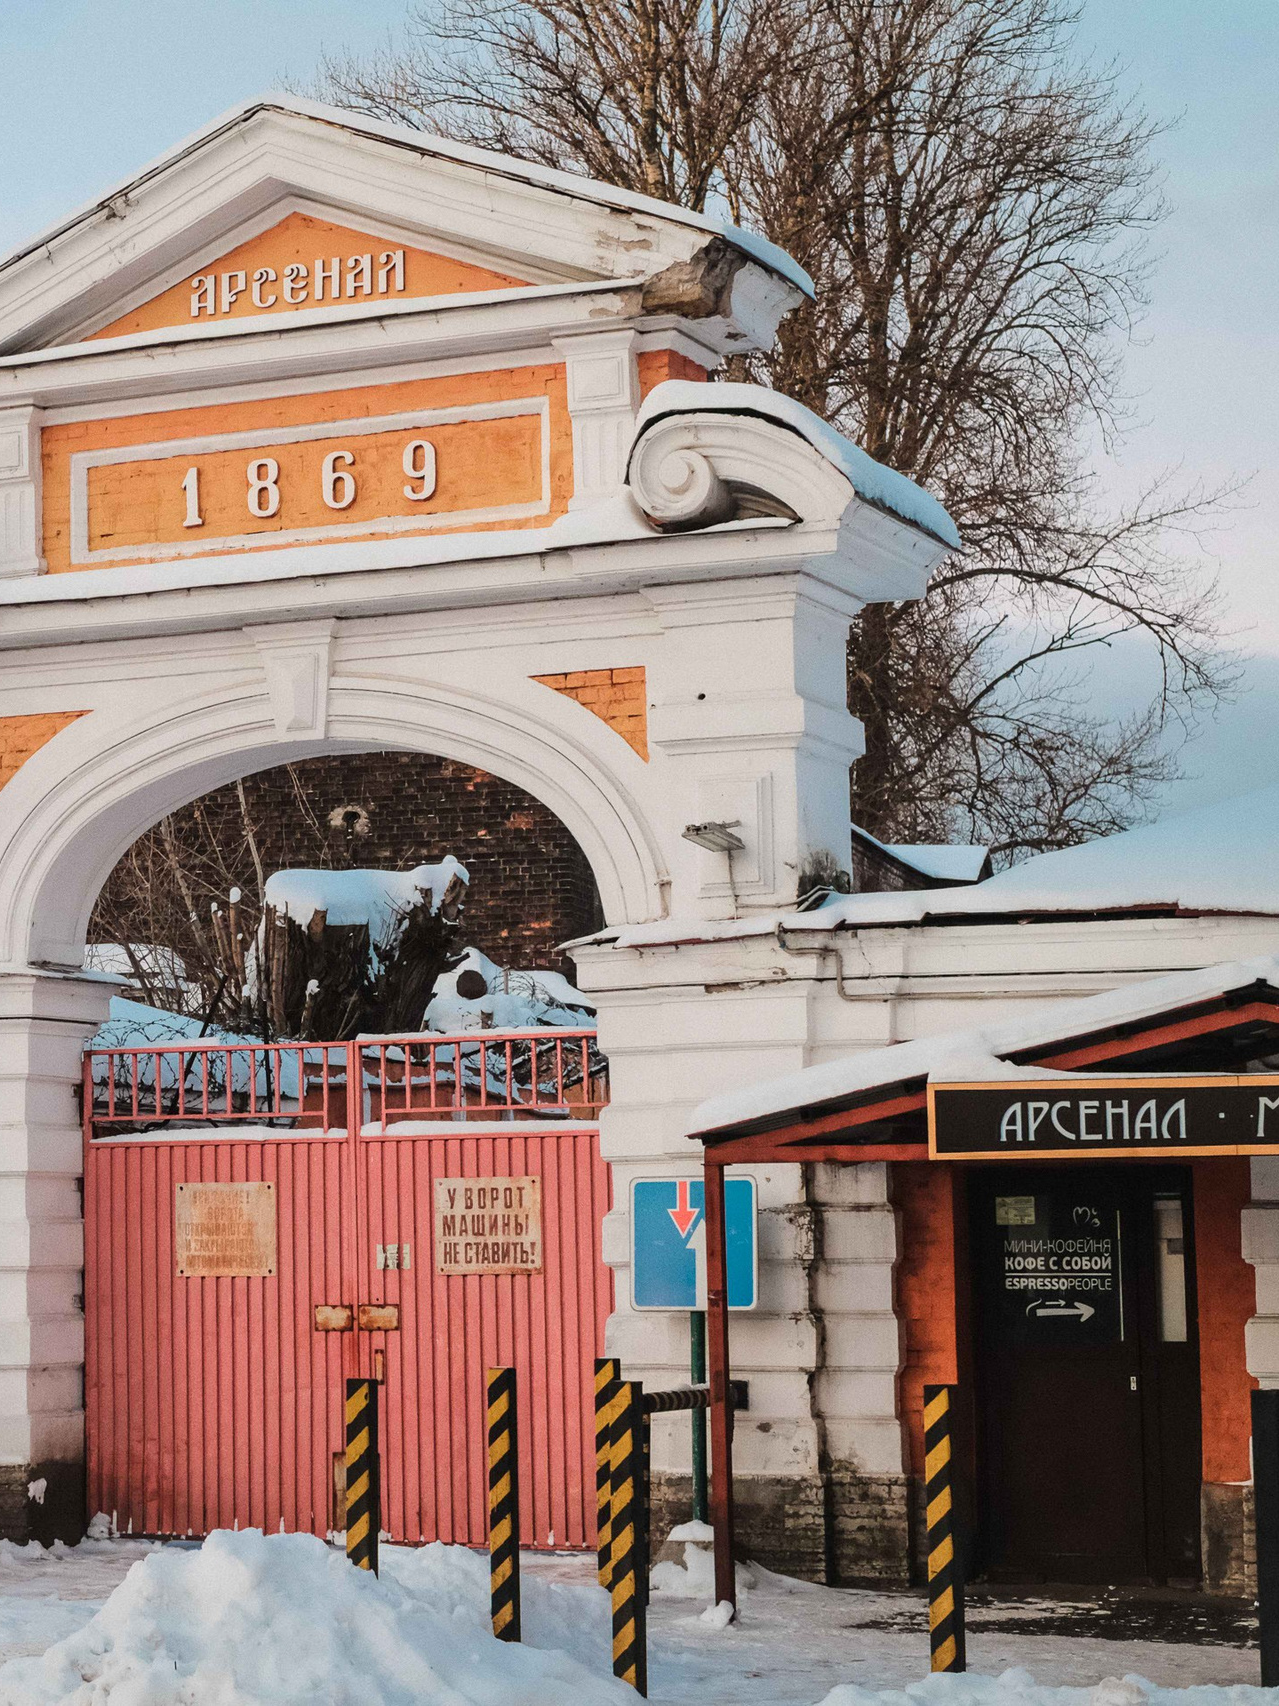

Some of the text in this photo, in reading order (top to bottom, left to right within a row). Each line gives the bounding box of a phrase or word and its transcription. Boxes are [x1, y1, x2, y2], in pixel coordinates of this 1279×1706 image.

[190, 249, 406, 318] АРСЕНАЛ
[181, 439, 437, 528] 1869
[999, 1098, 1187, 1142] АРСЕНАЛ
[447, 1187, 525, 1210] У ВОРОТ
[442, 1213, 529, 1237] МАШИНЫ
[443, 1241, 537, 1265] НЕ СТАВИТЬ!
[1004, 1236, 1112, 1253] МИНИ-КОФЕЙНЯ
[1004, 1252, 1112, 1270] КОФЕ С СОБОЙ
